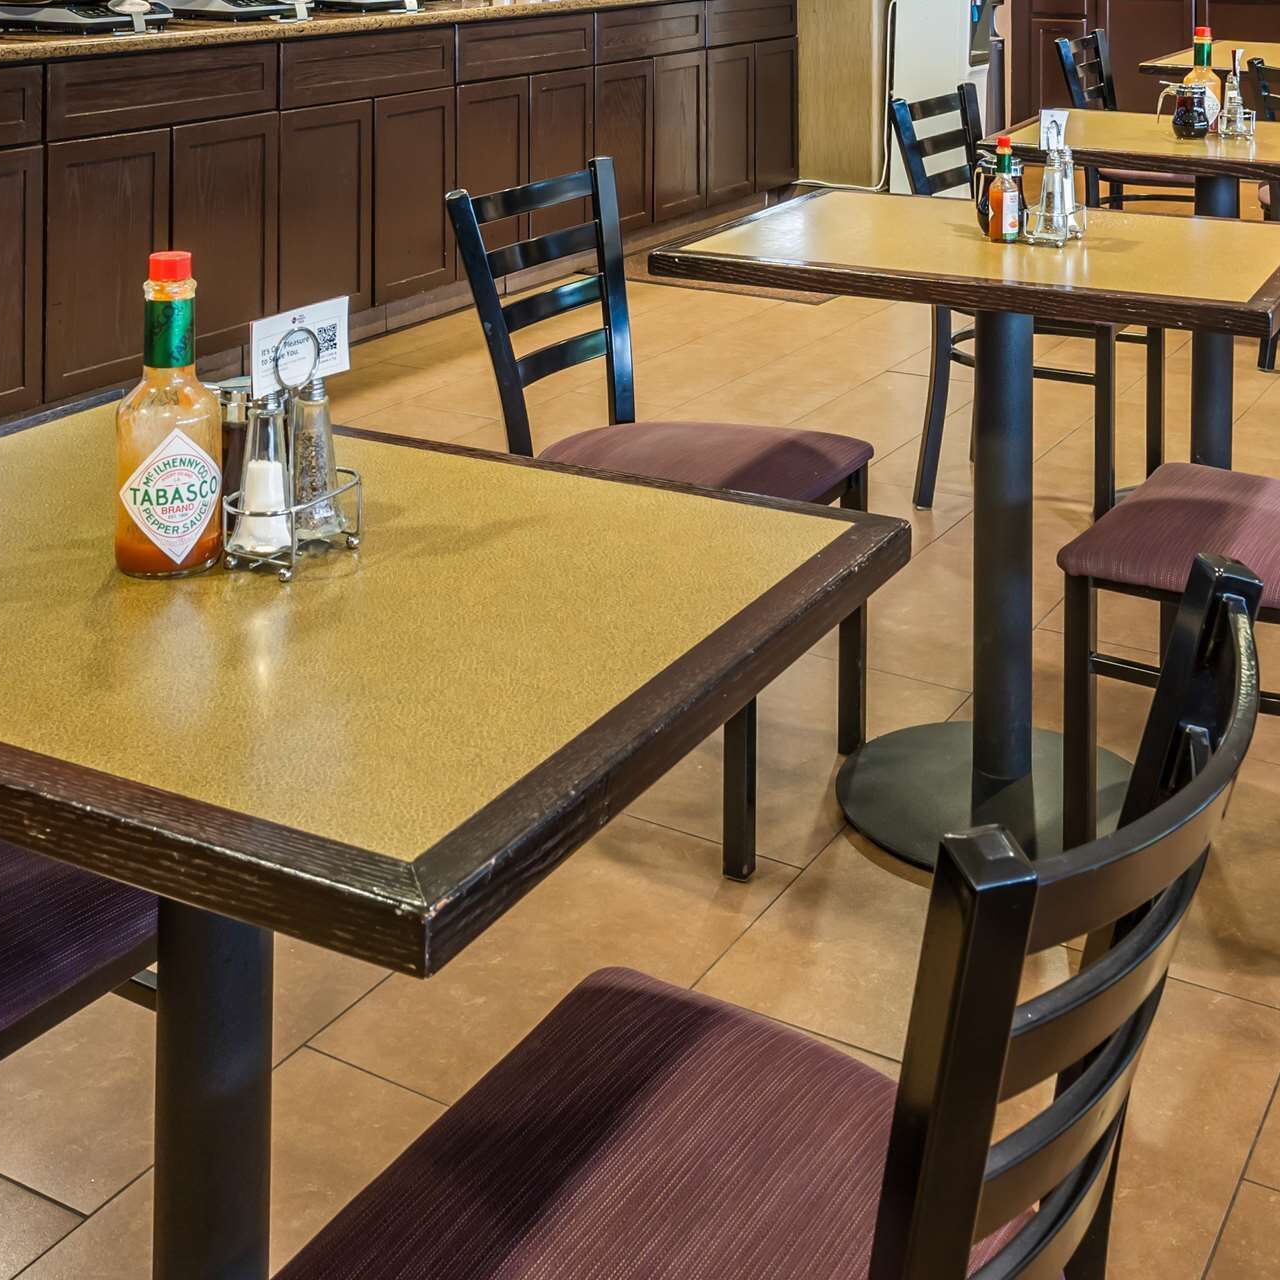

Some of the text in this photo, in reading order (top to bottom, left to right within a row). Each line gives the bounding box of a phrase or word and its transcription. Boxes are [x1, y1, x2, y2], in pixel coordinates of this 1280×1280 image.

[130, 475, 218, 507] TABASCO
[143, 500, 209, 535] PEPPER SAUCE
[161, 503, 195, 515] BRAND
